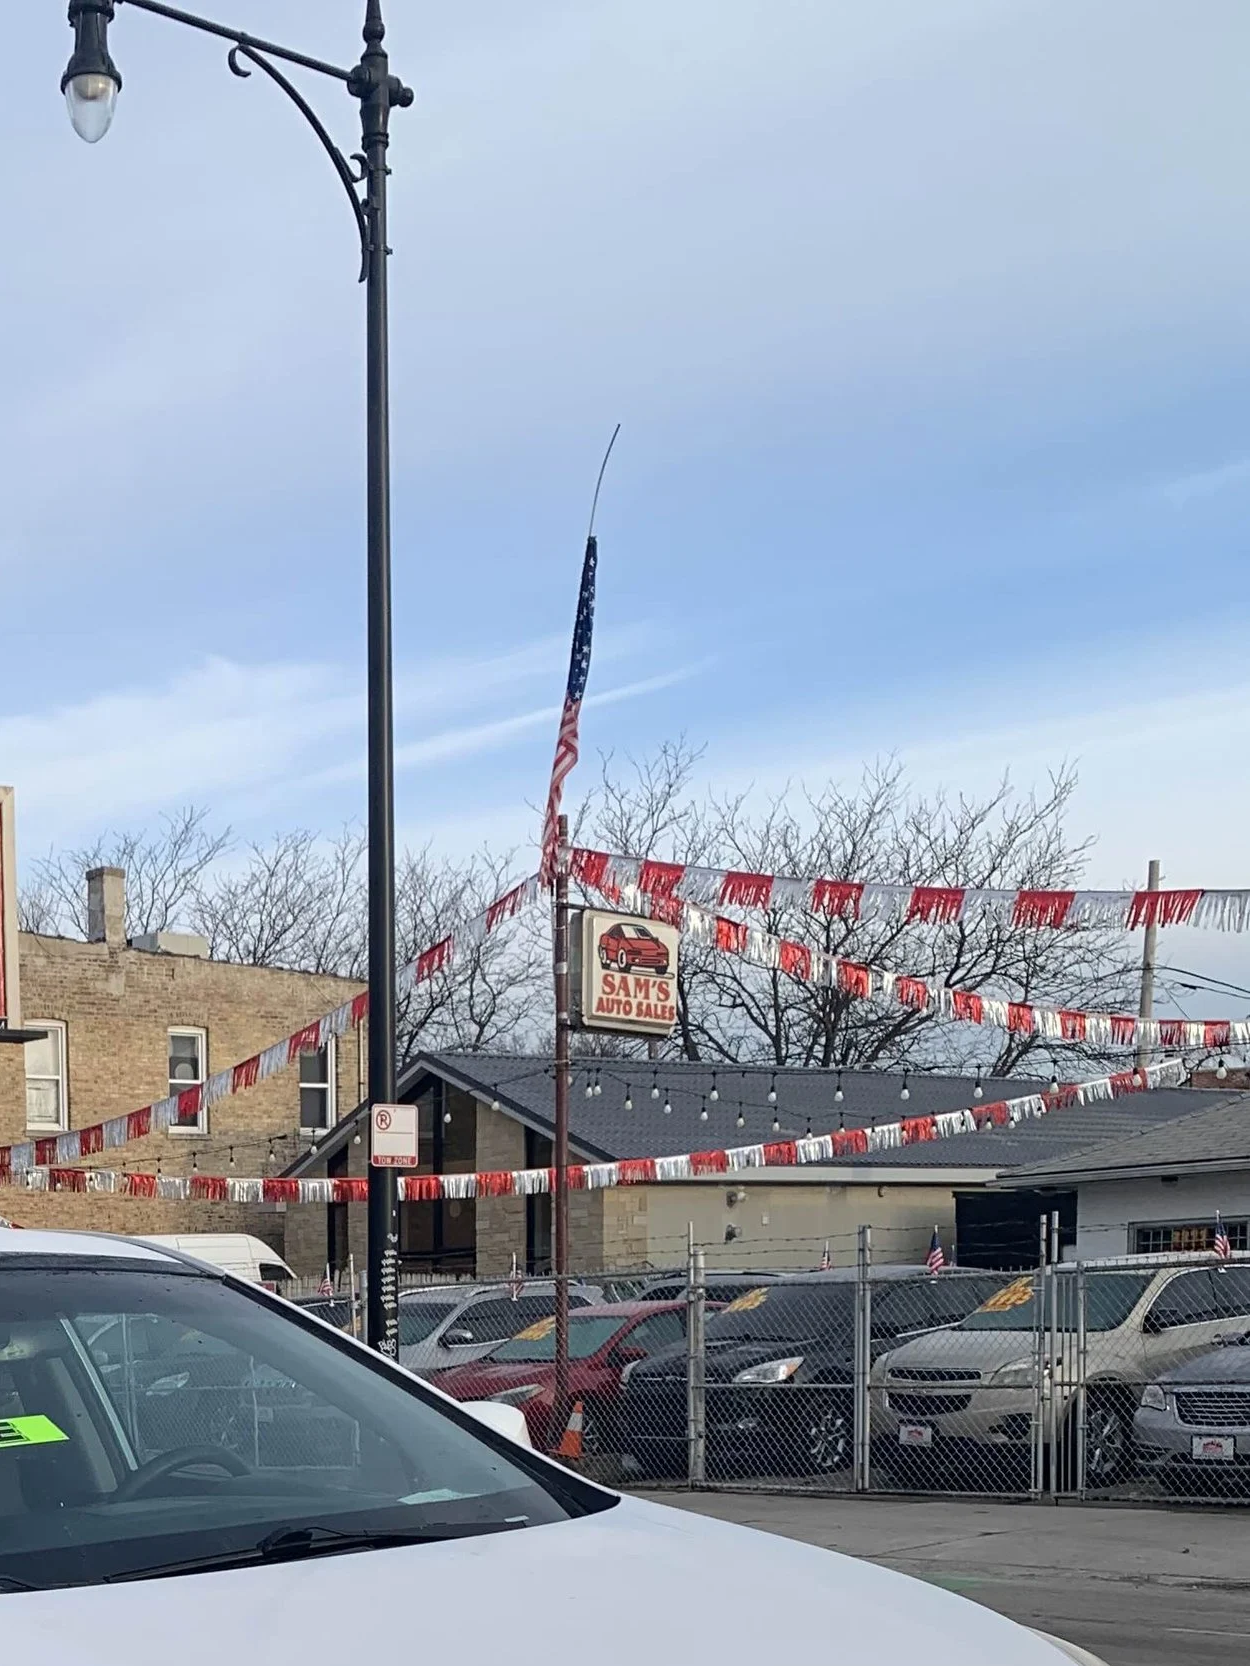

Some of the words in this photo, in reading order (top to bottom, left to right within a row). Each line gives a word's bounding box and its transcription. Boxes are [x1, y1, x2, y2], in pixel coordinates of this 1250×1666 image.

[602, 973, 670, 1002] SAM'S
[595, 997, 633, 1016] AUTO
[636, 1001, 675, 1021] SALES
[394, 1156, 412, 1165] ZONE
